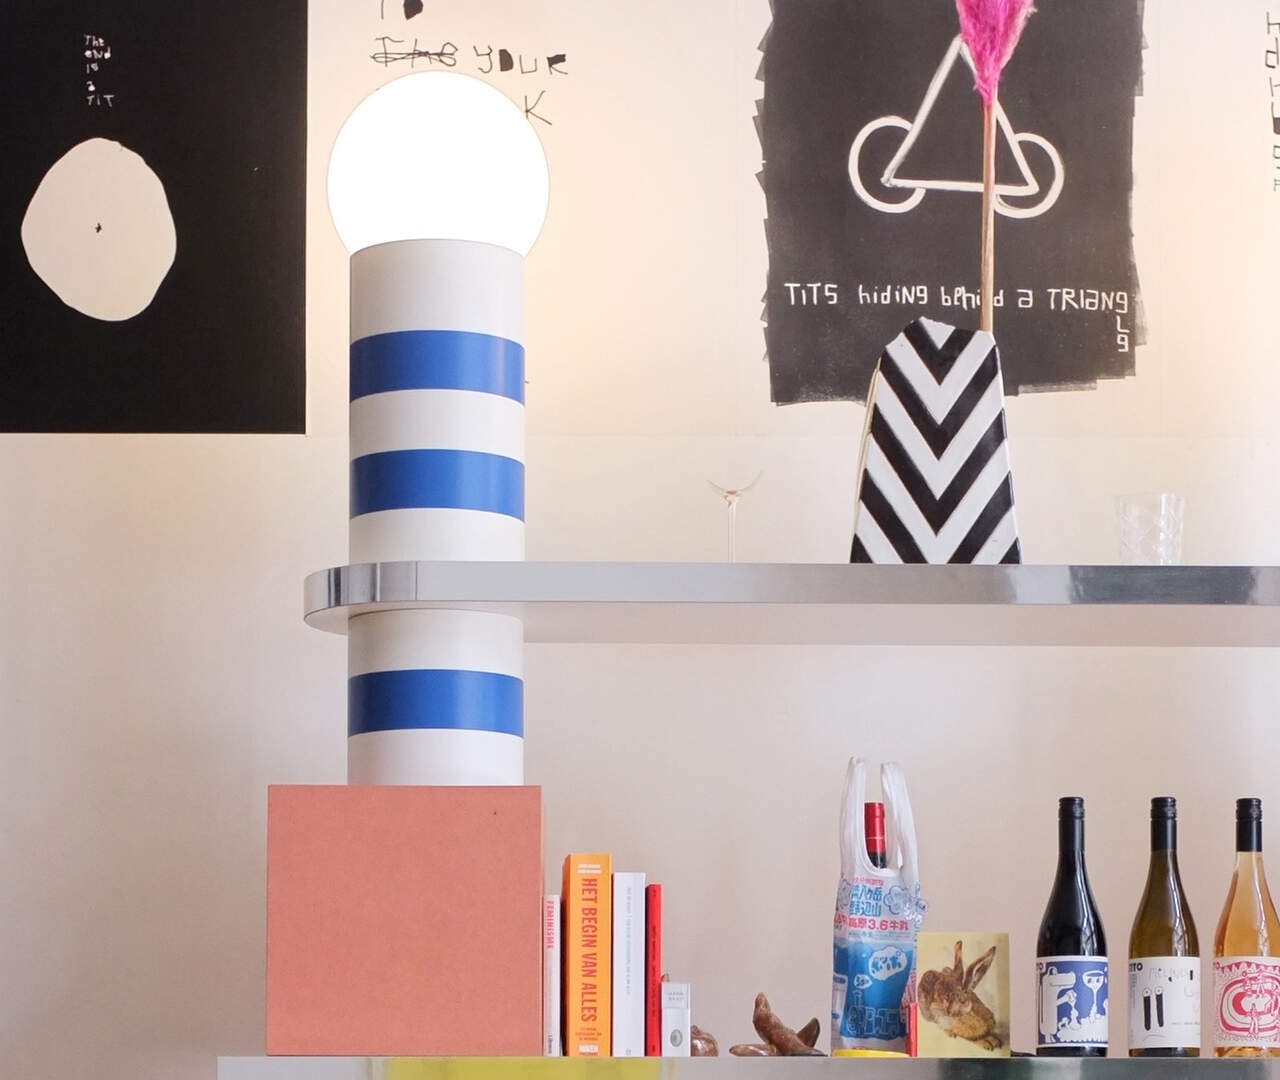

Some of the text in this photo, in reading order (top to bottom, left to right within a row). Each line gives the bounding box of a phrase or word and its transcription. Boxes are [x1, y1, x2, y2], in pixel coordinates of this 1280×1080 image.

[940, 286, 1004, 311] behid
[581, 877, 598, 904] HET
[581, 907, 598, 949] BEGIN
[581, 952, 598, 979] VAN
[581, 982, 598, 1023] ALLES
